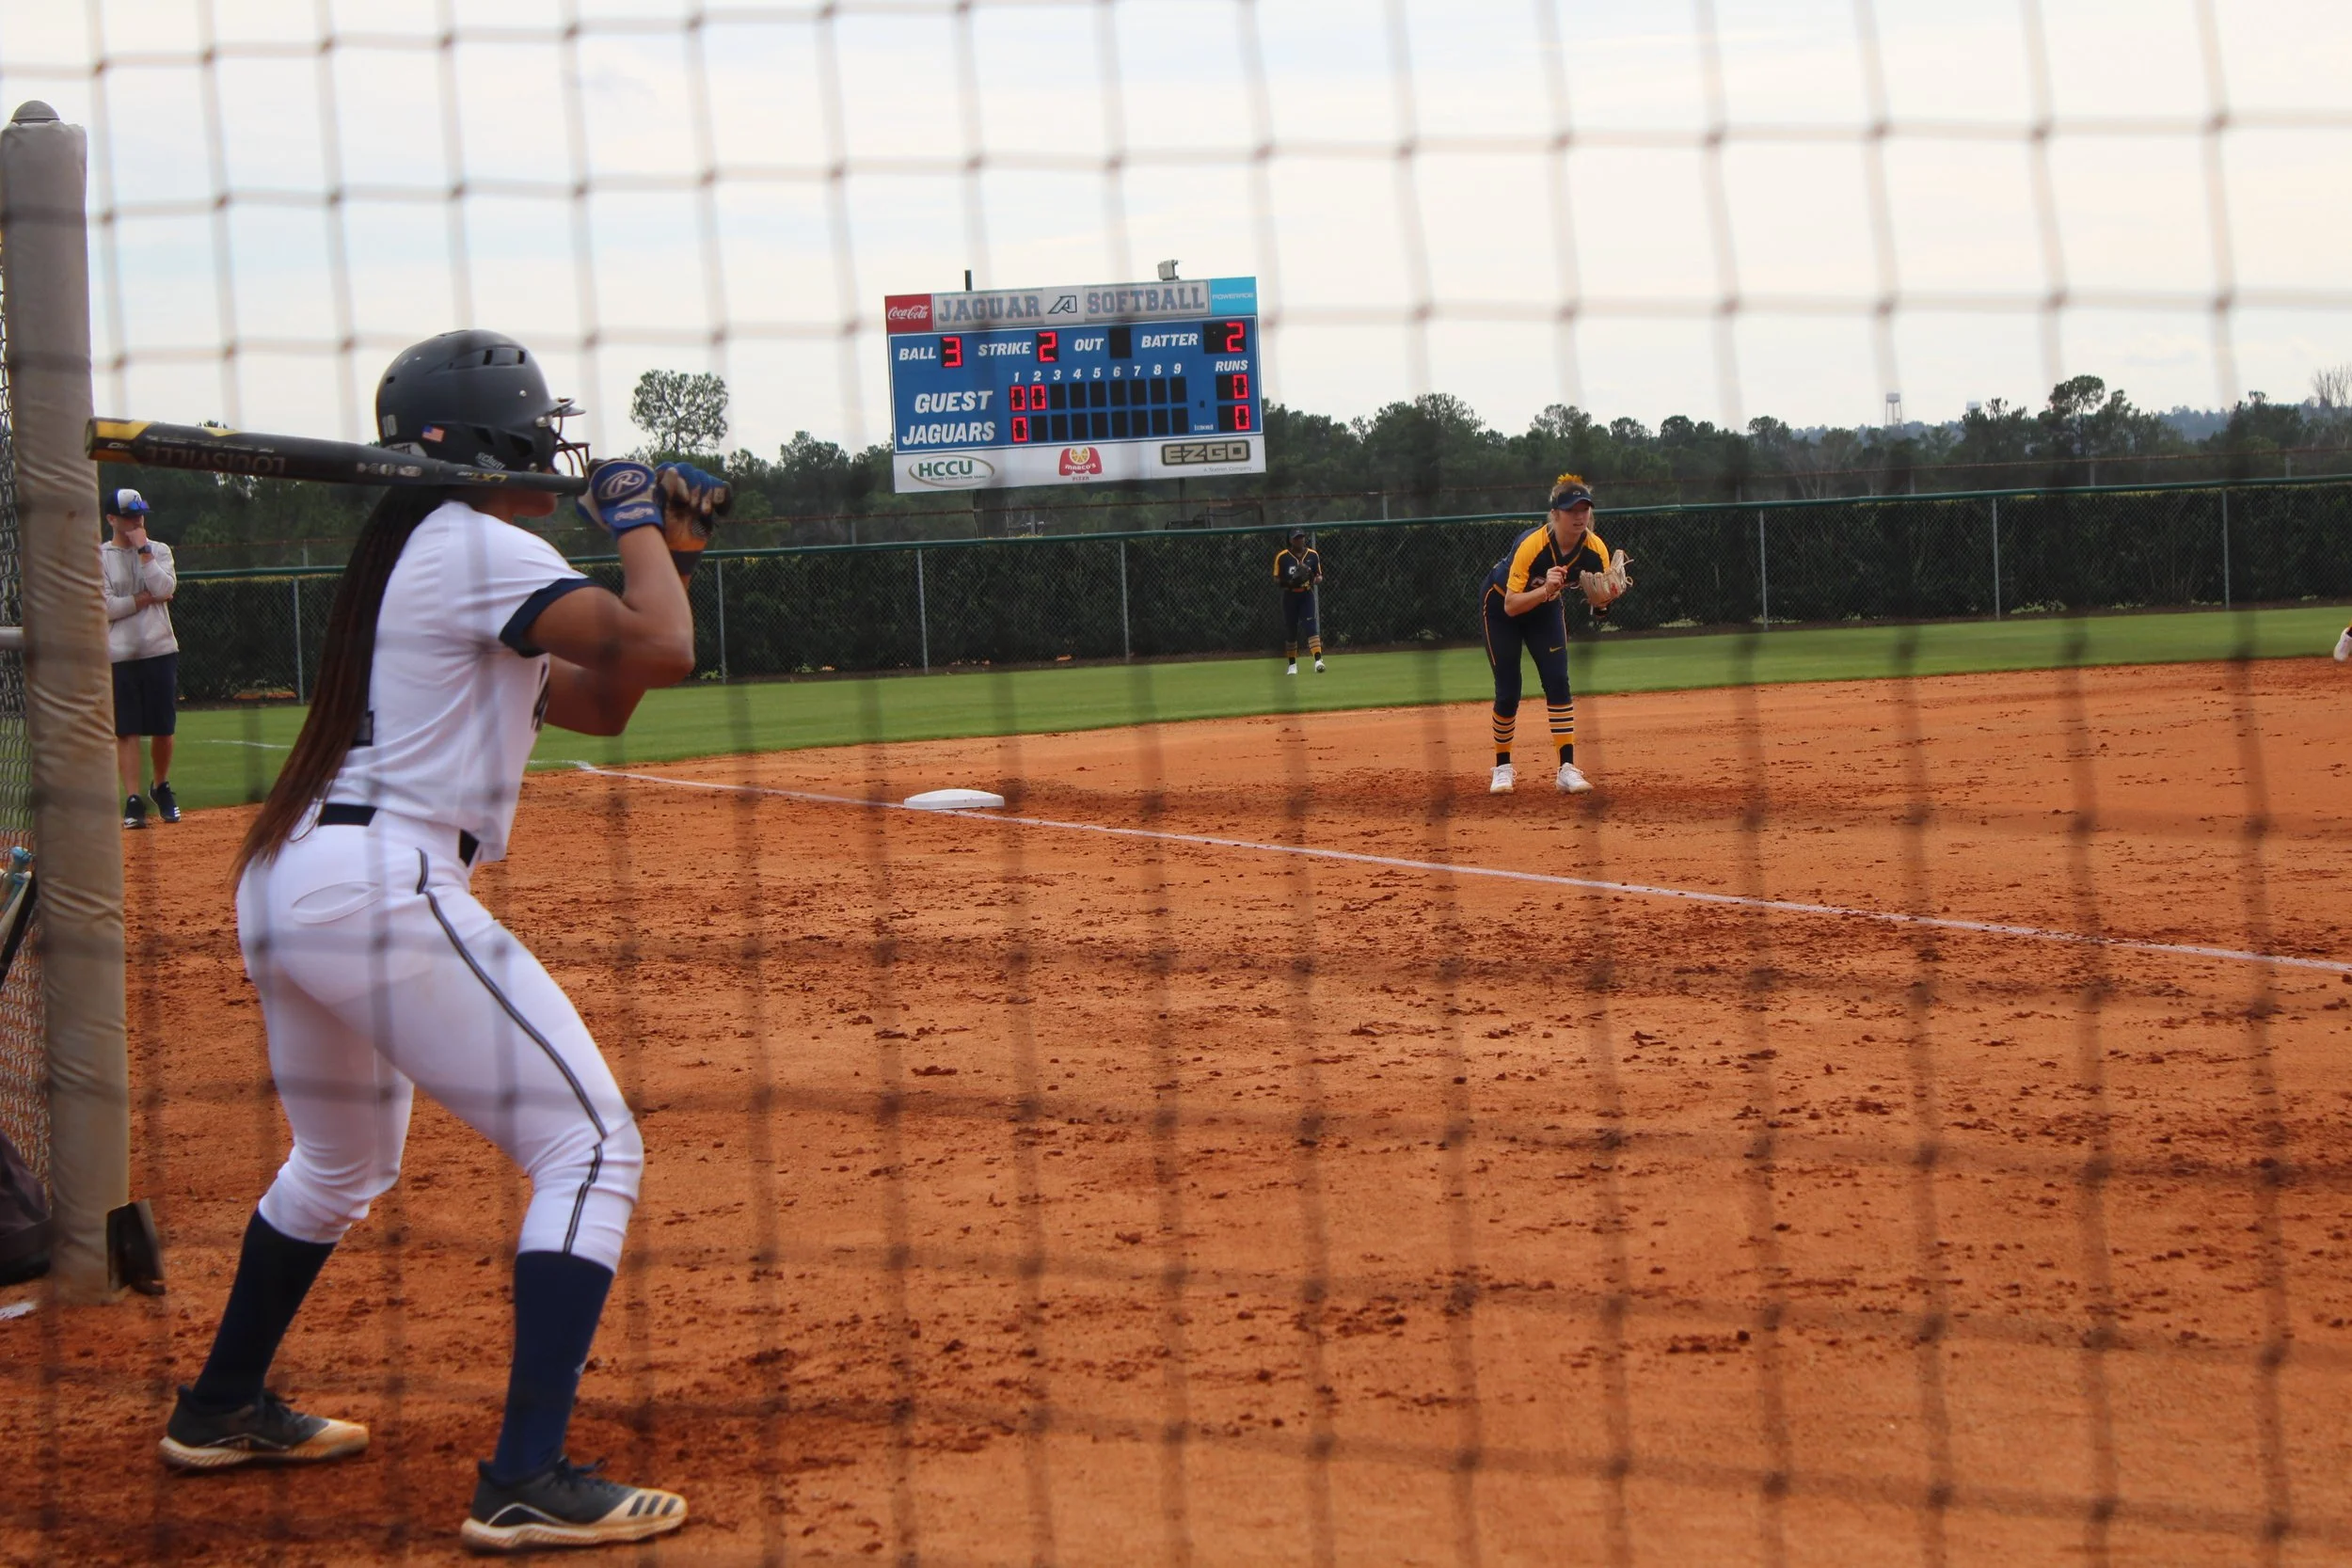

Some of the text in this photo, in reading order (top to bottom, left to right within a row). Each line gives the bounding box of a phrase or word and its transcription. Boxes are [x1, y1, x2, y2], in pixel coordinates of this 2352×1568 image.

[887, 304, 930, 321] Coca-Cola
[938, 295, 1042, 322] JAGUAR
[1087, 287, 1205, 315] SOFTBALL
[977, 341, 1032, 356] STRIKE
[1038, 331, 1057, 362] 2
[1074, 338, 1104, 352] OUT
[1141, 333, 1199, 348] BATTER
[1226, 321, 1245, 353] 2
[898, 347, 937, 361] BALL
[942, 336, 962, 368] 3
[1014, 363, 1182, 382] 1 2 3 4 5 6 7 8 9
[1215, 360, 1249, 372] RUNS
[1233, 374, 1249, 399] 0
[914, 390, 993, 414] GUEST
[1234, 404, 1250, 430] 0
[902, 421, 995, 446] JAGUARS
[1011, 416, 1028, 443] 0
[144, 446, 286, 473] LOUISVILLE
[1164, 442, 1248, 465] EZGO
[918, 460, 974, 478] HCCU
